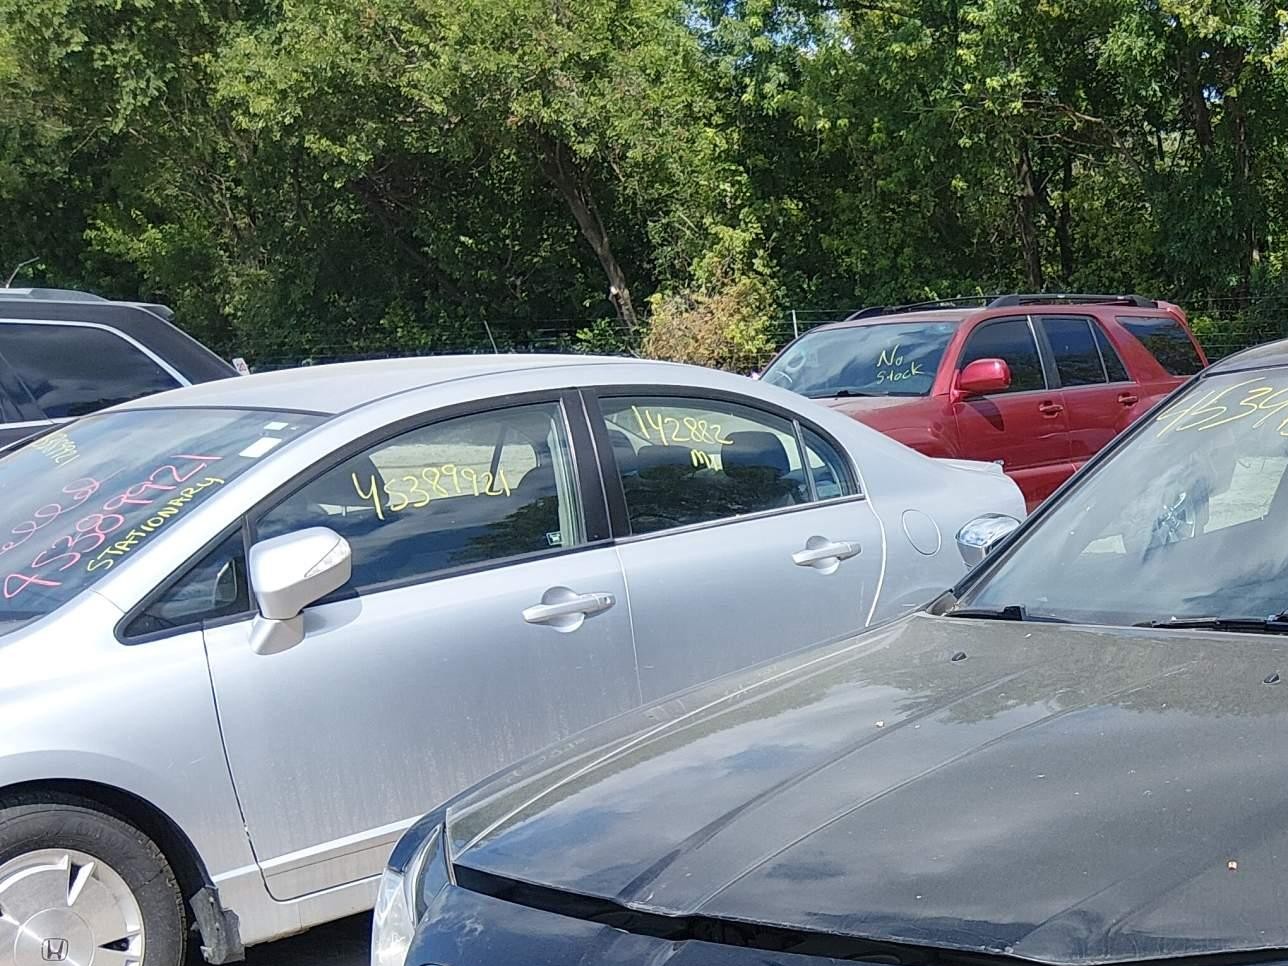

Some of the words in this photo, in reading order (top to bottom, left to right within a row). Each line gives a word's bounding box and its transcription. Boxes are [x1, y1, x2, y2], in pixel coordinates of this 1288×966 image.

[876, 343, 904, 367] No
[631, 405, 734, 446] 142882
[352, 464, 511, 521] 45389921
[4, 454, 224, 598] 45389921
[87, 477, 225, 573] STATIONARY
